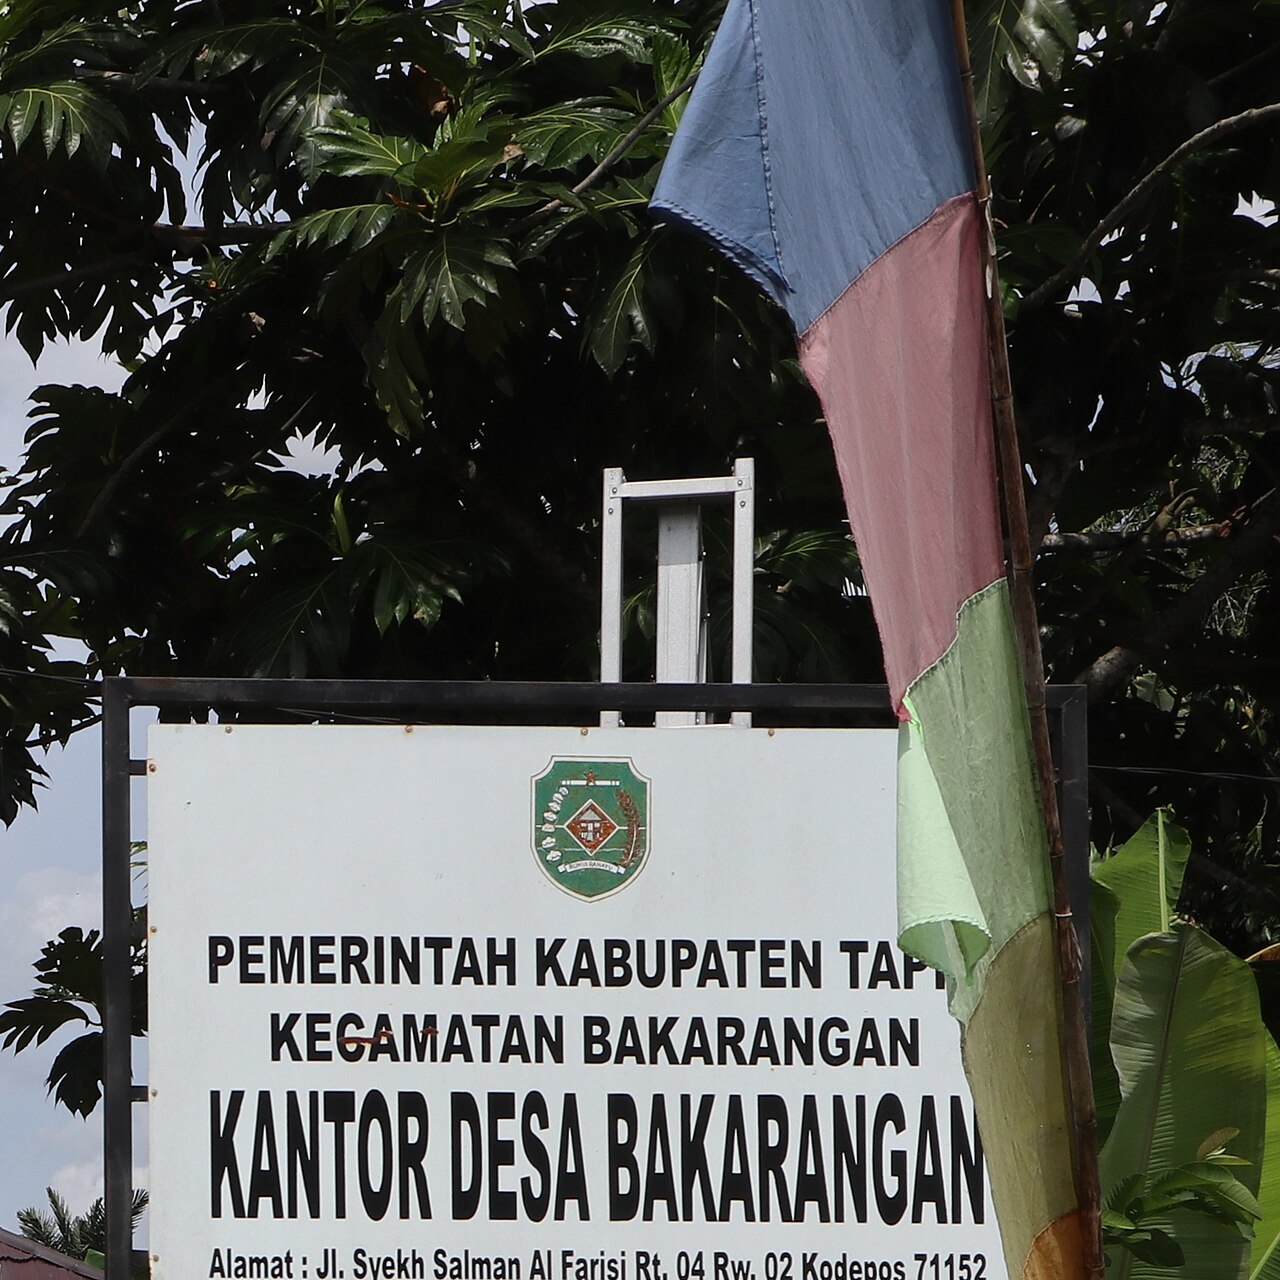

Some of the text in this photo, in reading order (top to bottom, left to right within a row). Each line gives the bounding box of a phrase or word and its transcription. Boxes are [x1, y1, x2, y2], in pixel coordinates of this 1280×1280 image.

[208, 935, 513, 987] PEMERINTAH
[535, 938, 823, 989] KABUPATEN
[270, 1012, 920, 1068] KECAMATAN BAKARANGAN
[209, 1089, 986, 1225] KANTOR DESA BAKARANGAN
